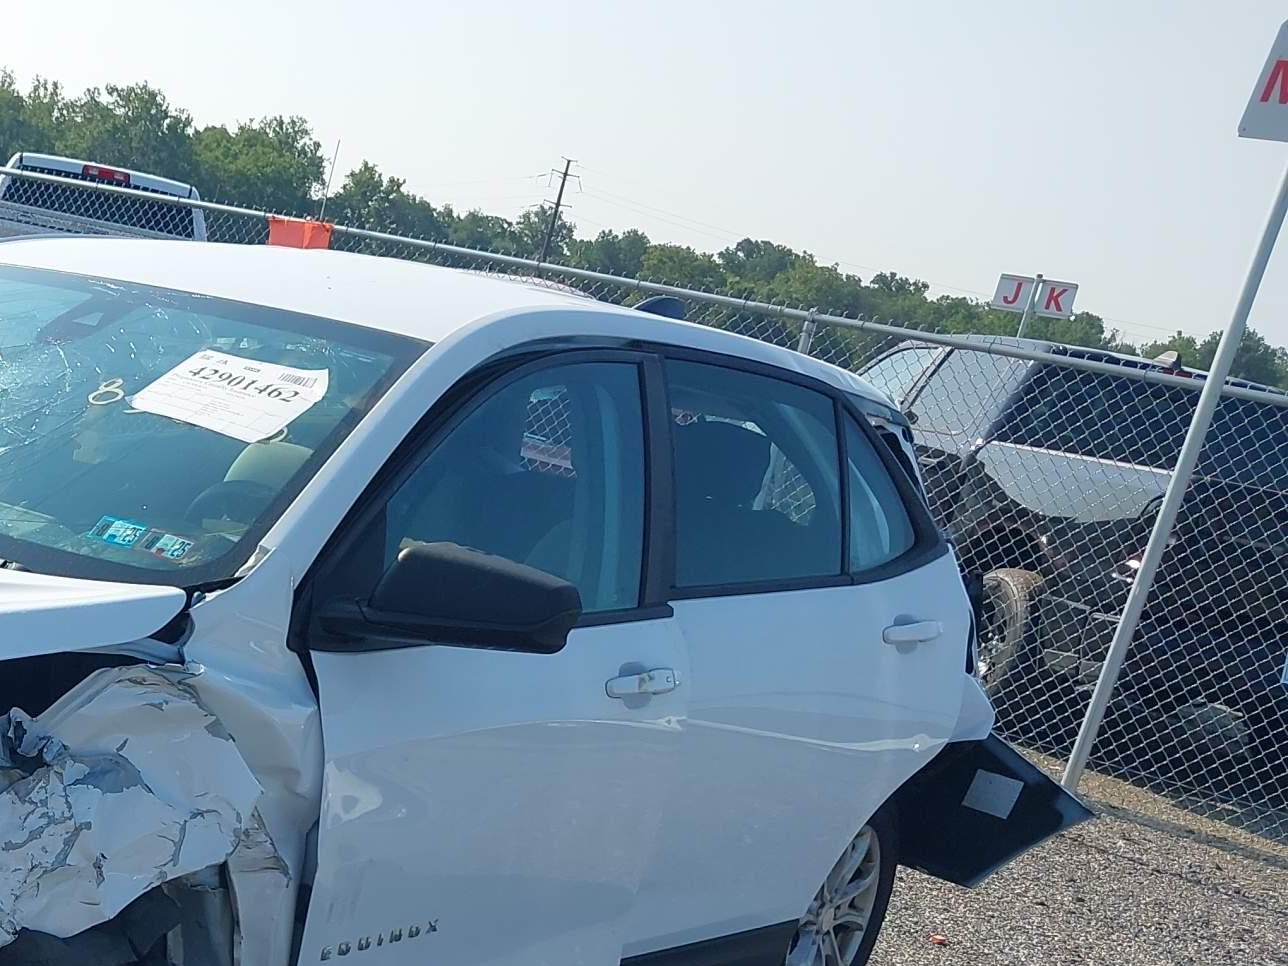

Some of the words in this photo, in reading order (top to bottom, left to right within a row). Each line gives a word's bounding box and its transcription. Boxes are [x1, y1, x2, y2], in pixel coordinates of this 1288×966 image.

[1003, 282, 1023, 304] J
[1045, 287, 1068, 312] K
[188, 366, 301, 403] 42901462
[320, 918, 440, 961] EQUINOX
